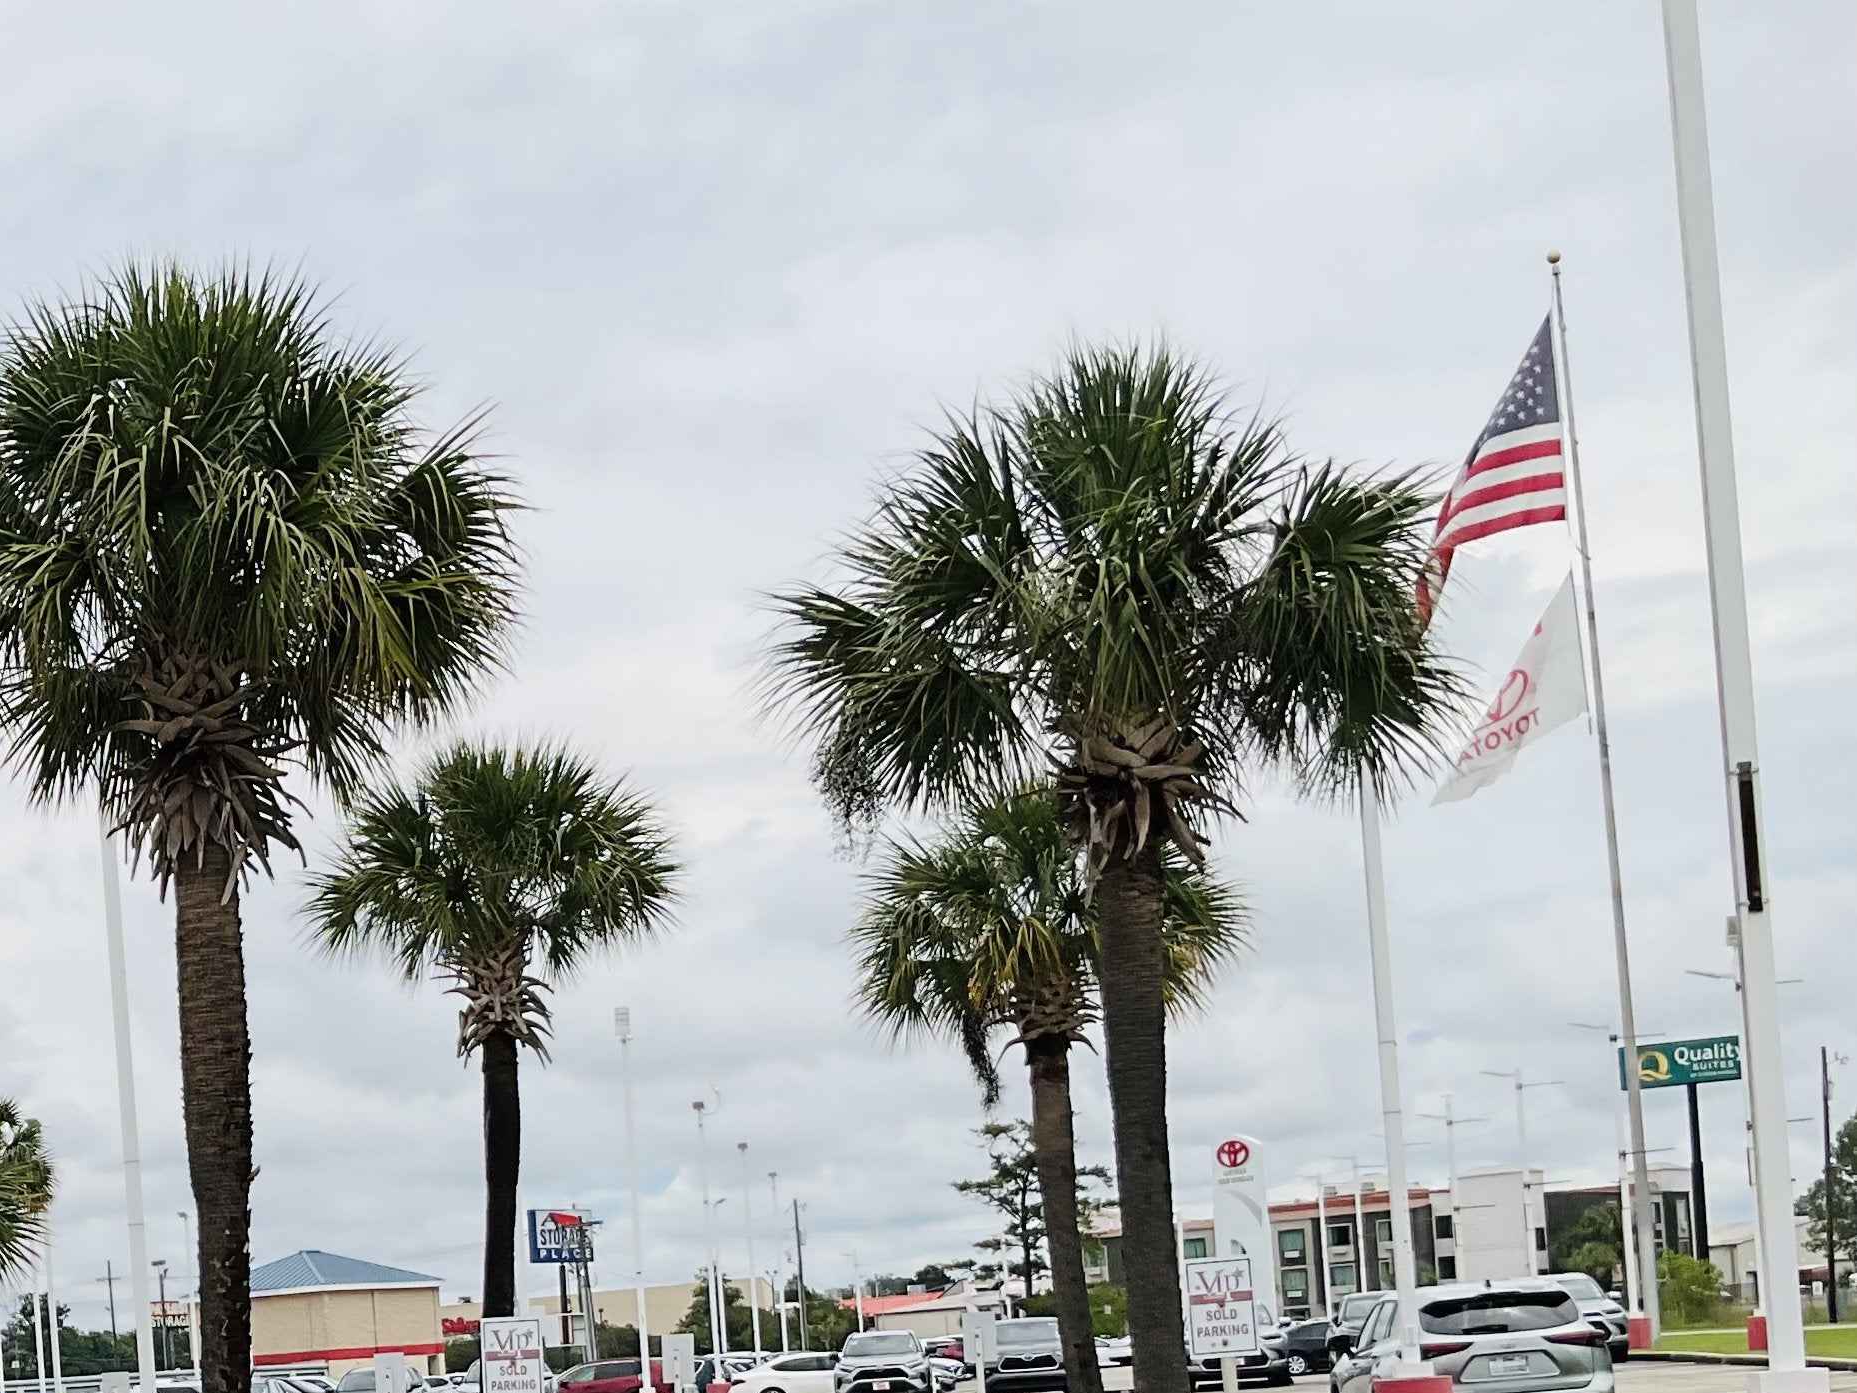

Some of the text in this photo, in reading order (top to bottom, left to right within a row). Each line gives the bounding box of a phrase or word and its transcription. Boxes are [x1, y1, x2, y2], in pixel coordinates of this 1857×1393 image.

[1206, 1309, 1238, 1321] SOLD
[1197, 1323, 1250, 1338] PARKING
[499, 1365, 527, 1376] SOLD
[491, 1379, 536, 1391] PARKING
